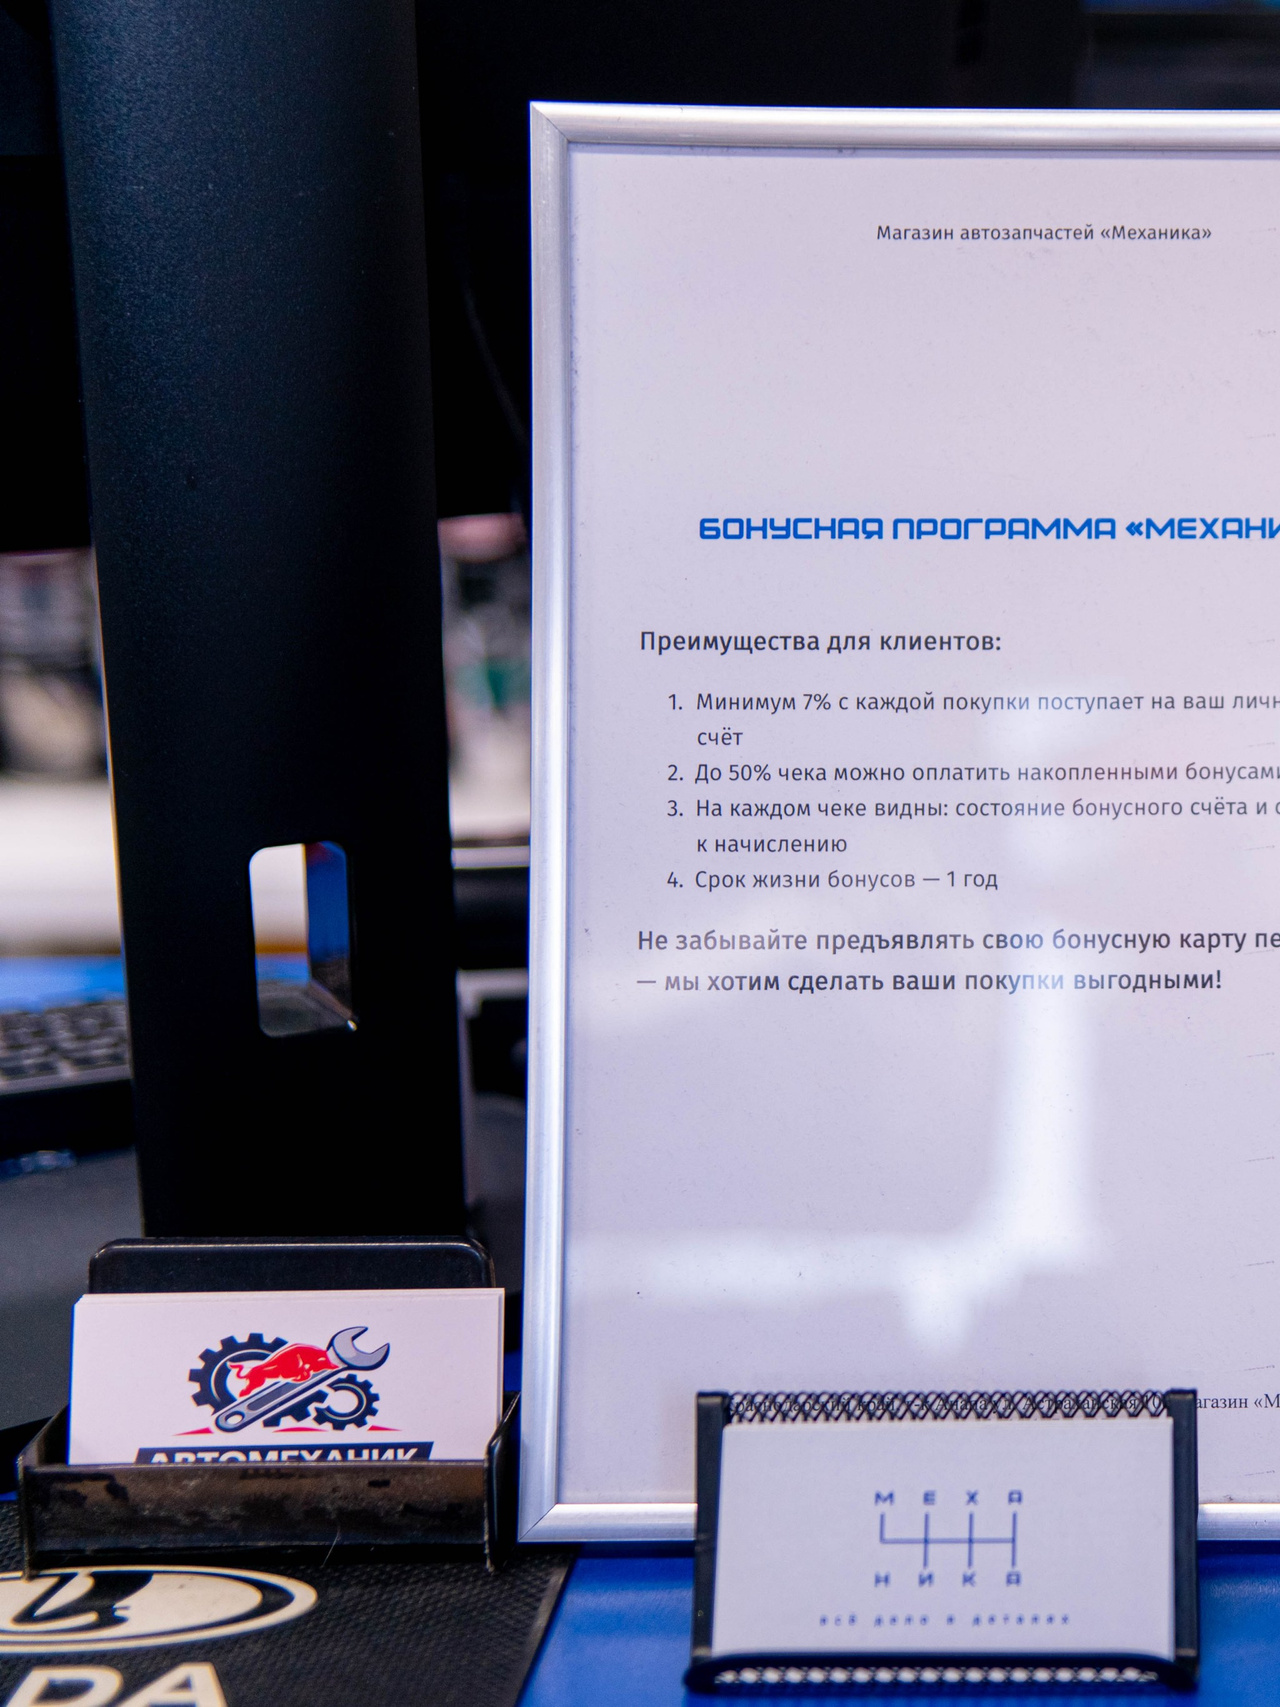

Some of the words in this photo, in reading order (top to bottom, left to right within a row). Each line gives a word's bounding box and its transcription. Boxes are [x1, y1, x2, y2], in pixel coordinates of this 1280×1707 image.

[876, 224, 954, 241] Магазин
[959, 223, 1094, 242] автозапчастей
[1100, 224, 1212, 241] «Механика»
[699, 517, 884, 540] БОНУСНАЯ
[892, 517, 1117, 541] ПРОГРАММА
[640, 630, 821, 656] Преимущества
[826, 634, 871, 655] для
[880, 634, 1002, 652] клиентов:
[667, 693, 683, 711] 1.
[696, 692, 797, 716] Минимум
[802, 692, 832, 711] 7%
[838, 695, 849, 711] с
[856, 690, 935, 714] каждой
[943, 695, 1030, 717] покупки
[1037, 695, 1145, 716] поступает
[1151, 695, 1176, 710] на
[1183, 695, 1225, 710] ваш
[697, 726, 744, 746] счёт
[667, 763, 684, 782] 2.
[694, 763, 723, 785] До
[728, 763, 772, 782] 50%
[778, 766, 827, 782] чека
[833, 766, 906, 782] можно
[912, 766, 1011, 782] оплатить
[1017, 766, 1178, 782] накопленными
[666, 799, 684, 818] 3.
[696, 798, 723, 817] На
[730, 802, 811, 821] каждом
[817, 802, 867, 817] чеке
[874, 802, 949, 821] видны:
[955, 802, 1066, 817] состояние
[1072, 797, 1183, 821] бонусного
[1190, 796, 1248, 816] счёта
[1255, 801, 1268, 816] и
[697, 838, 708, 853] к
[714, 838, 848, 853] начислению
[666, 870, 684, 889] 4.
[695, 870, 747, 893] Срок
[752, 873, 820, 889] жизни
[827, 869, 916, 893] бонусов
[946, 870, 955, 888] 1
[963, 873, 999, 891] год
[638, 930, 669, 951] Не
[675, 928, 808, 951] забывайте
[816, 933, 975, 956] предъявлять
[982, 932, 1044, 950] свою
[1052, 927, 1172, 955] бонусную
[1179, 932, 1248, 954] карту
[664, 975, 699, 991] мы
[706, 975, 780, 992] хотим
[787, 974, 885, 995] сделать
[892, 974, 956, 991] ваши
[965, 973, 1064, 996] покупки
[1073, 969, 1222, 994] выгодными!
[1195, 1396, 1249, 1410] агазин
